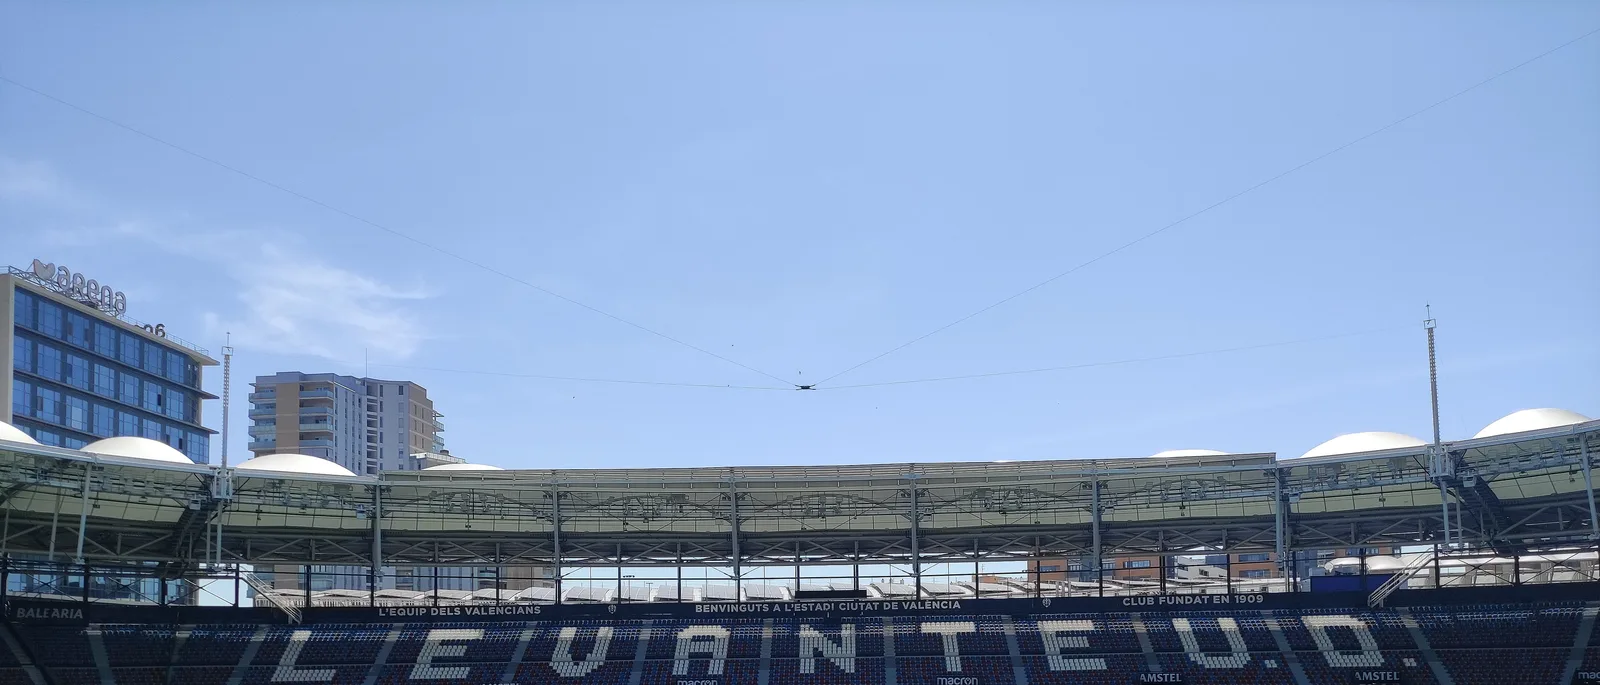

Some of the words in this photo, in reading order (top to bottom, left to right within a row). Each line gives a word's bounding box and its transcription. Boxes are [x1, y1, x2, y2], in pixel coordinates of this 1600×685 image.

[1122, 597, 1155, 606] CLUB
[1158, 595, 1210, 605] FUNDAT
[1212, 595, 1231, 604] EN
[1234, 594, 1265, 604] 1909
[430, 607, 461, 616] DELS
[464, 606, 541, 616] VALENCIANS
[695, 604, 769, 613] BENVINGUTS
[773, 604, 781, 612] A
[838, 602, 880, 611] CIUTAT
[883, 602, 899, 610] DE
[902, 599, 961, 610] VALÈNCIA
[936, 677, 979, 685] macron
[1139, 673, 1182, 683] AMSTEL
[1354, 671, 1400, 681] AMSTEL
